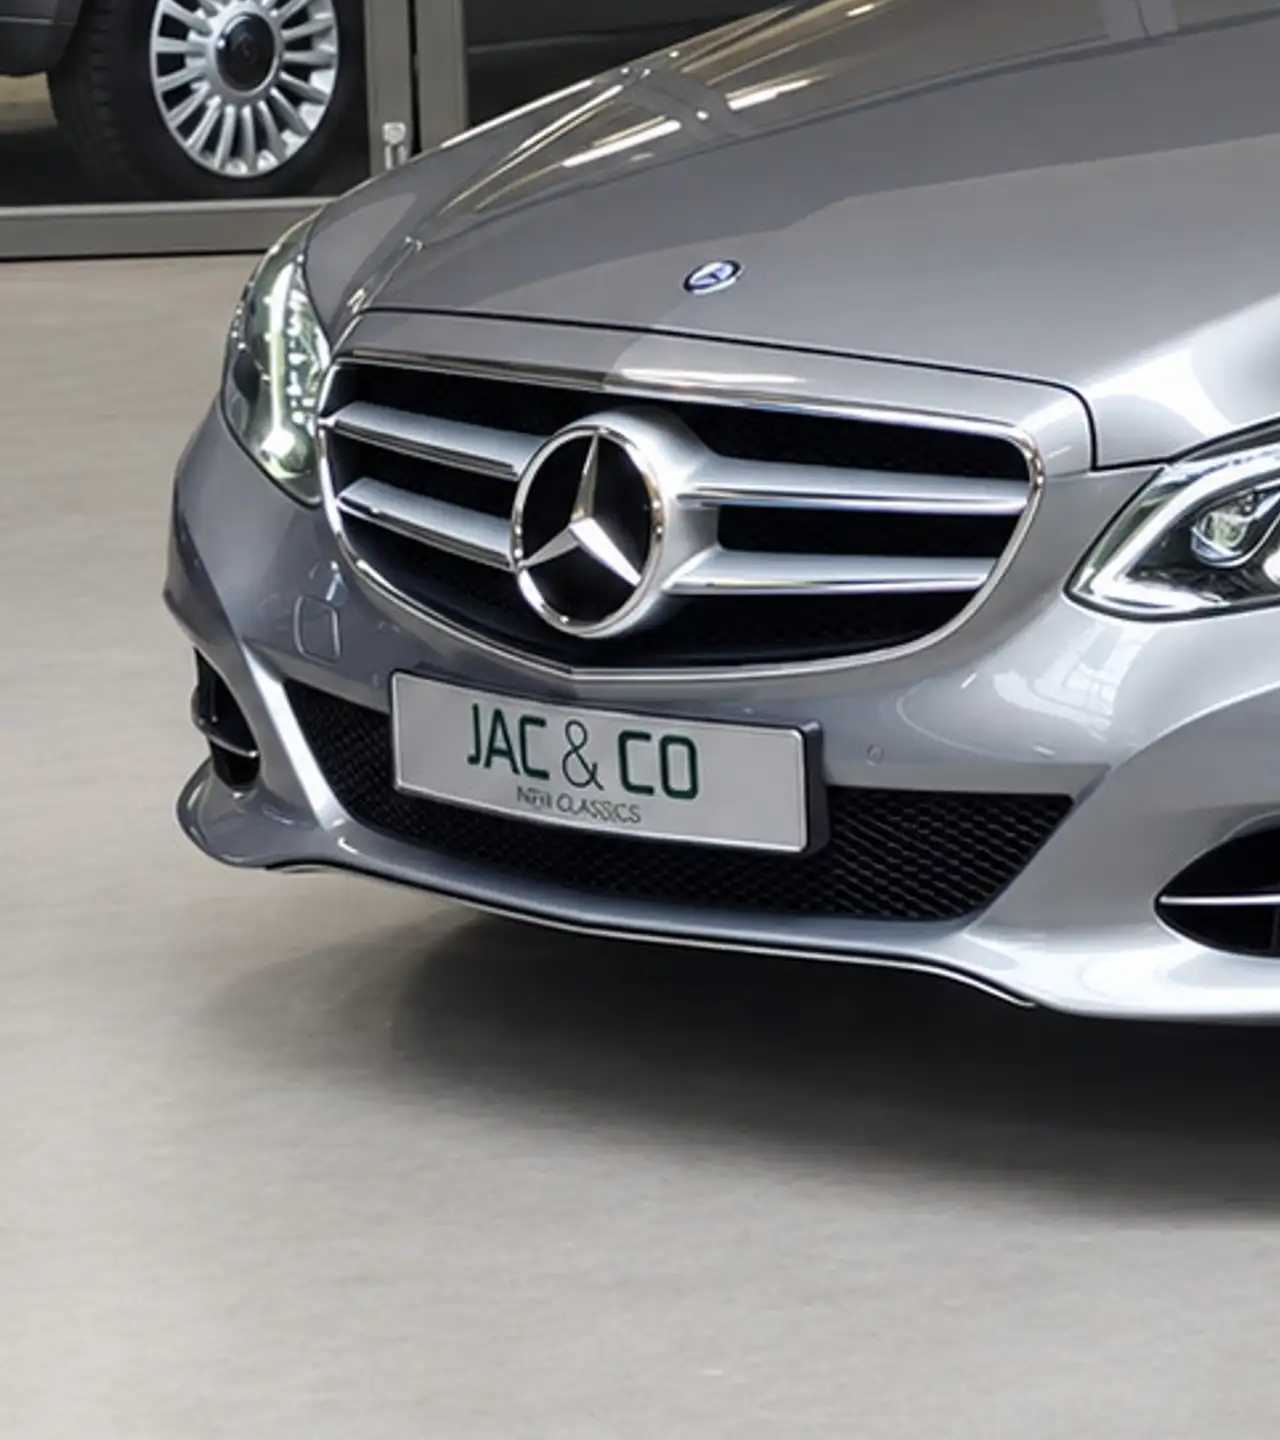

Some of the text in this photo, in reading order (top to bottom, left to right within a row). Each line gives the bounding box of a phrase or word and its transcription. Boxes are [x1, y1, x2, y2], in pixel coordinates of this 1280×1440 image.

[467, 703, 698, 800] JAC & CO
